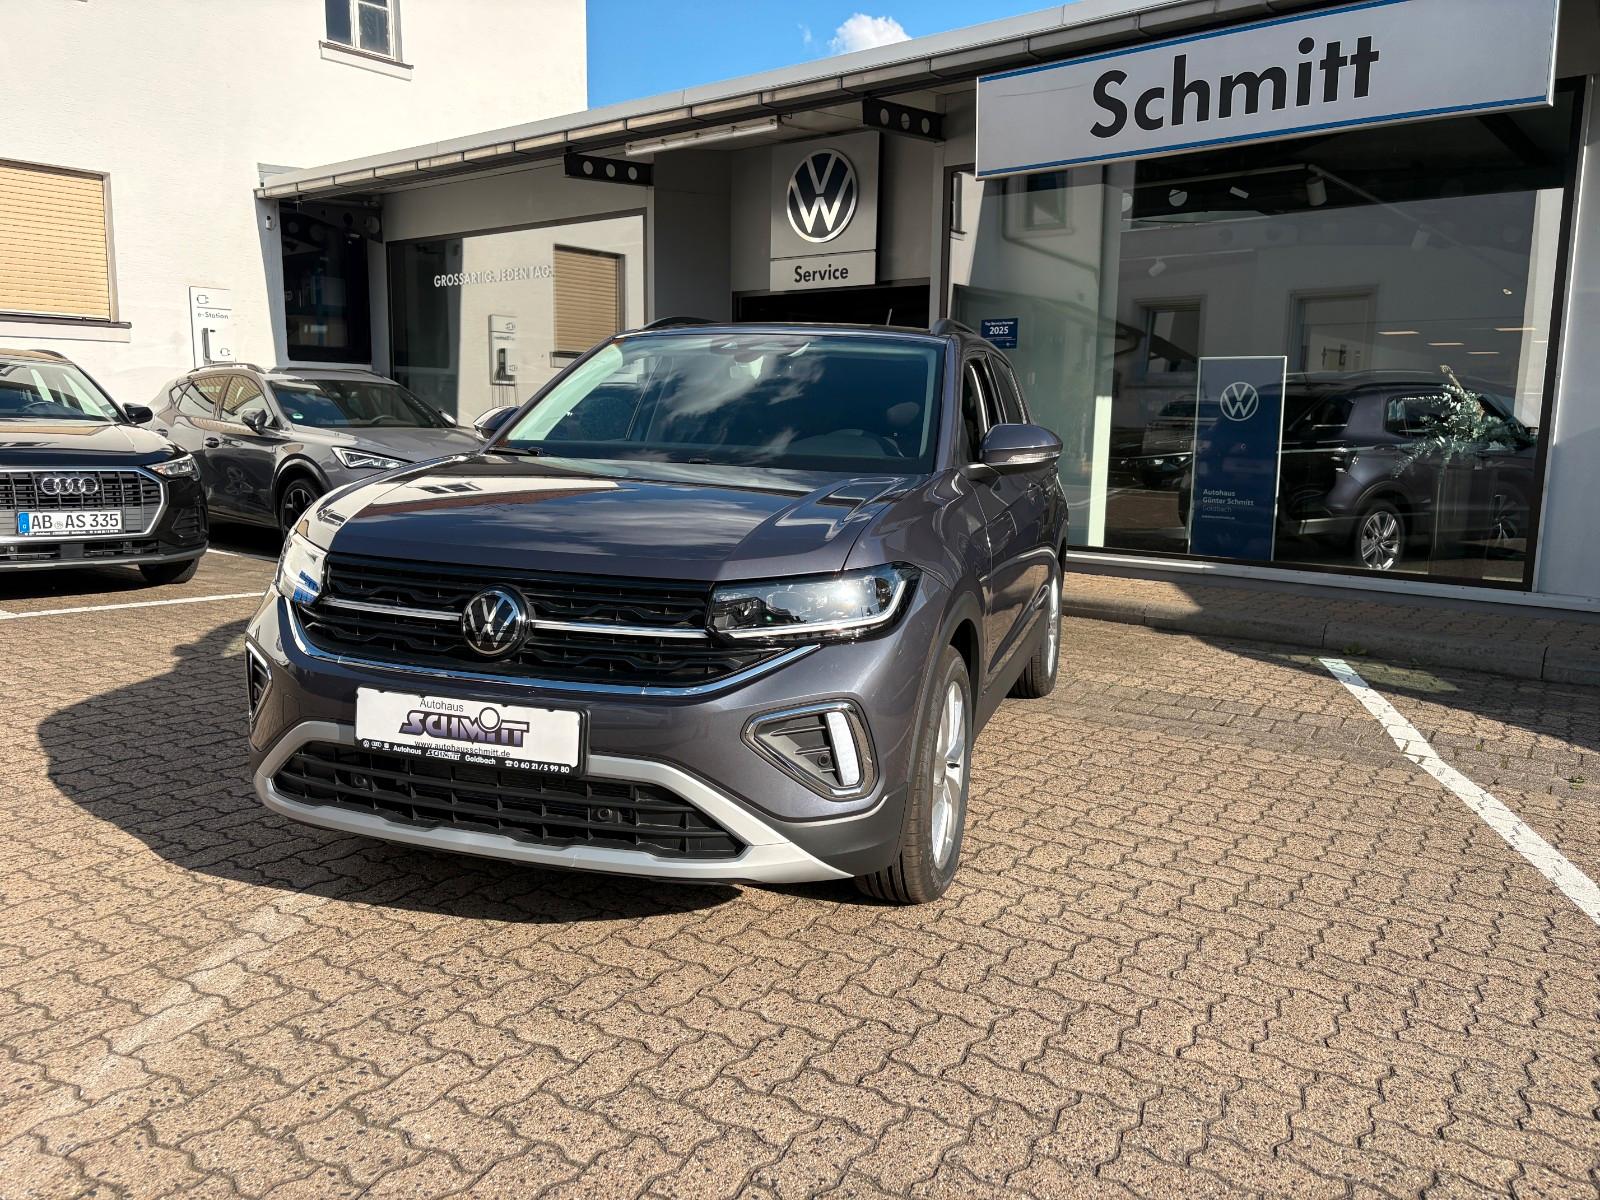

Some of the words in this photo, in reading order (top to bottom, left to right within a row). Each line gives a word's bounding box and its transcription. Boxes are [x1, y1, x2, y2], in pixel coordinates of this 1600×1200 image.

[1089, 35, 1380, 139] Schmitt
[433, 270, 497, 288] GROSSARTIG.
[499, 265, 530, 282] JEDEN
[794, 263, 849, 283] Service
[197, 311, 229, 320] e-Station
[989, 326, 1009, 335] 2025
[1202, 488, 1236, 497] Autohaus
[1226, 498, 1255, 506] Schmitt
[31, 514, 53, 529] AB
[65, 514, 86, 528] AS
[89, 513, 119, 528] 335
[419, 697, 464, 713] Autohaus
[392, 744, 422, 755] Autohaus
[464, 754, 497, 766] Goldbach
[513, 760, 519, 768] 0
[520, 761, 530, 769] 60
[560, 766, 570, 774] 80
